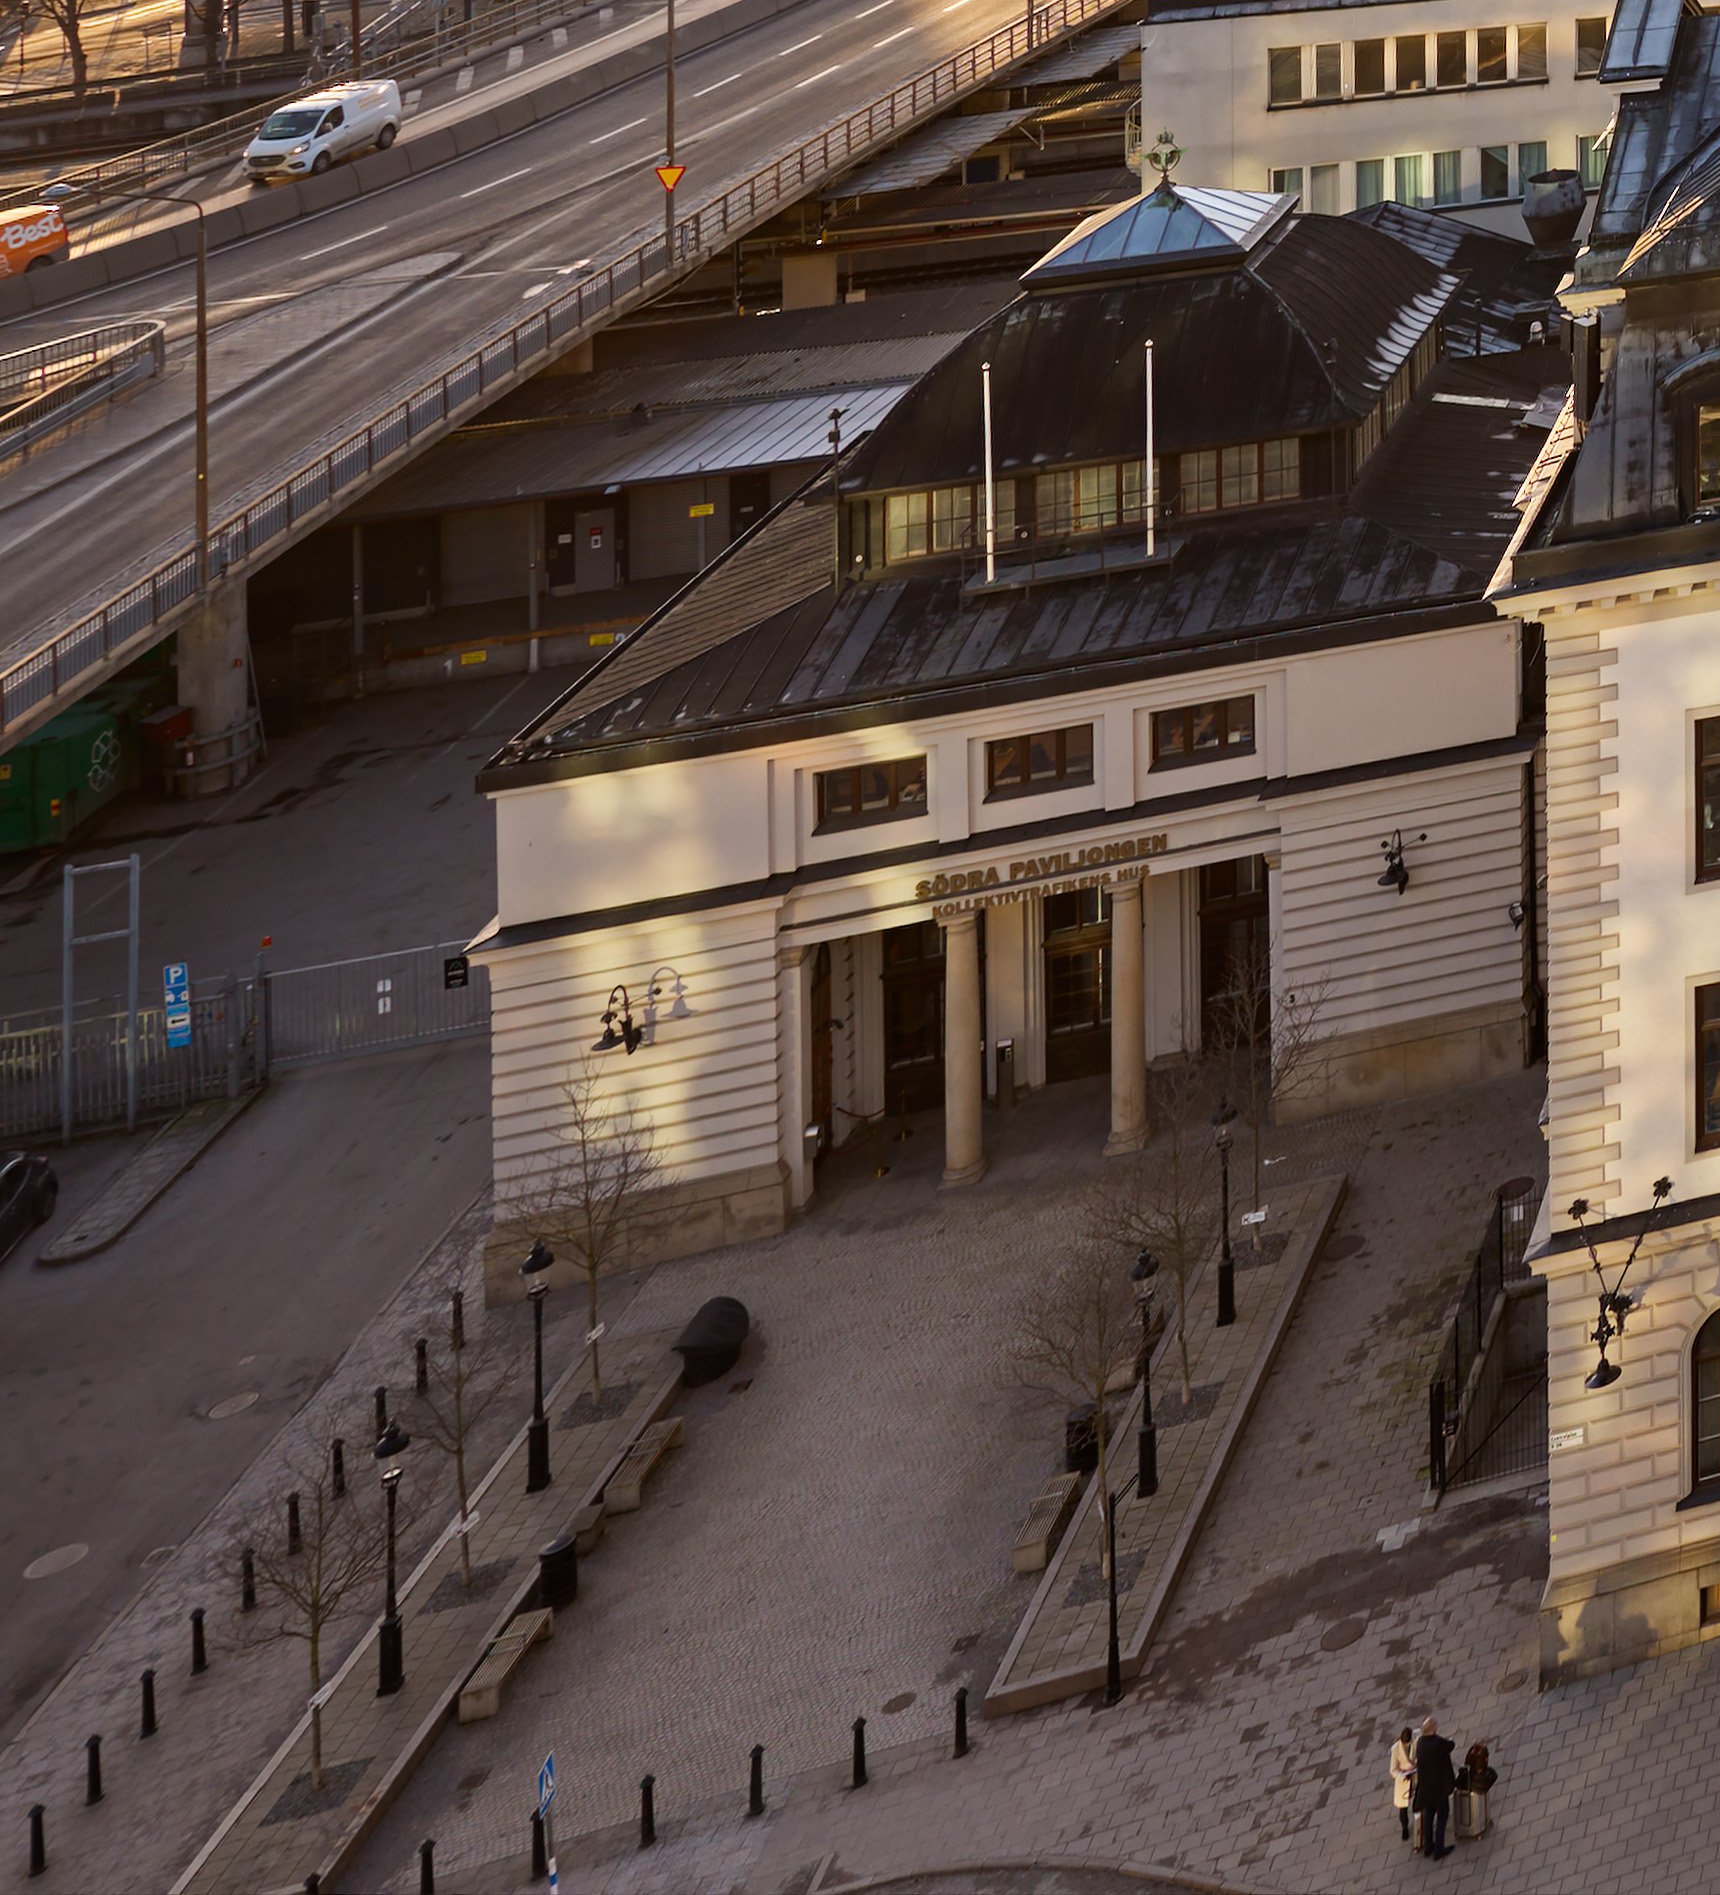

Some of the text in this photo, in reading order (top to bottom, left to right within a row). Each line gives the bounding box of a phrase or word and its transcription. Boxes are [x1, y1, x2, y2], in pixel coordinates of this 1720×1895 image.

[5, 214, 64, 249] Best
[914, 833, 1168, 899] SÖDRA PAVILJONGEN
[932, 864, 1151, 918] KOLLEKTIVTRAFIKENS HUS
[170, 967, 183, 984] P
